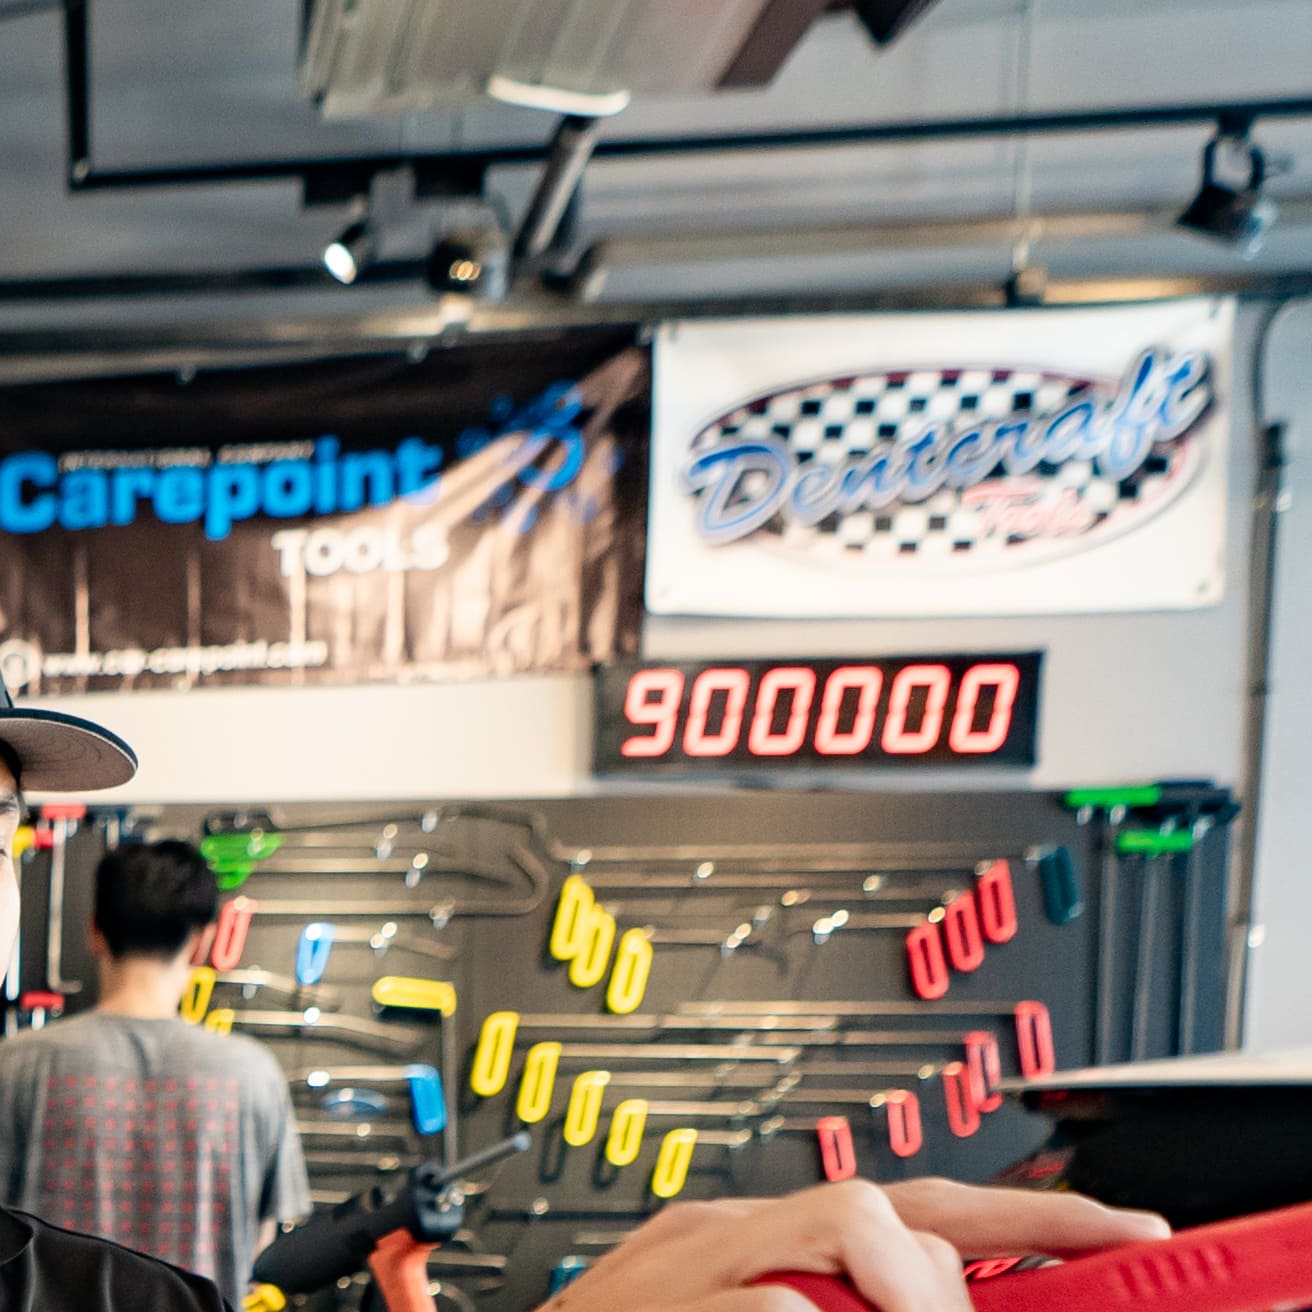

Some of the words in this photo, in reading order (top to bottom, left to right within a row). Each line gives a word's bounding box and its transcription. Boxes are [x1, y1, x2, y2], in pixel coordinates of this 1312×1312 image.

[683, 346, 1214, 546] Dentcraft
[272, 522, 451, 578] TOOLS
[620, 663, 1021, 757] 900000
